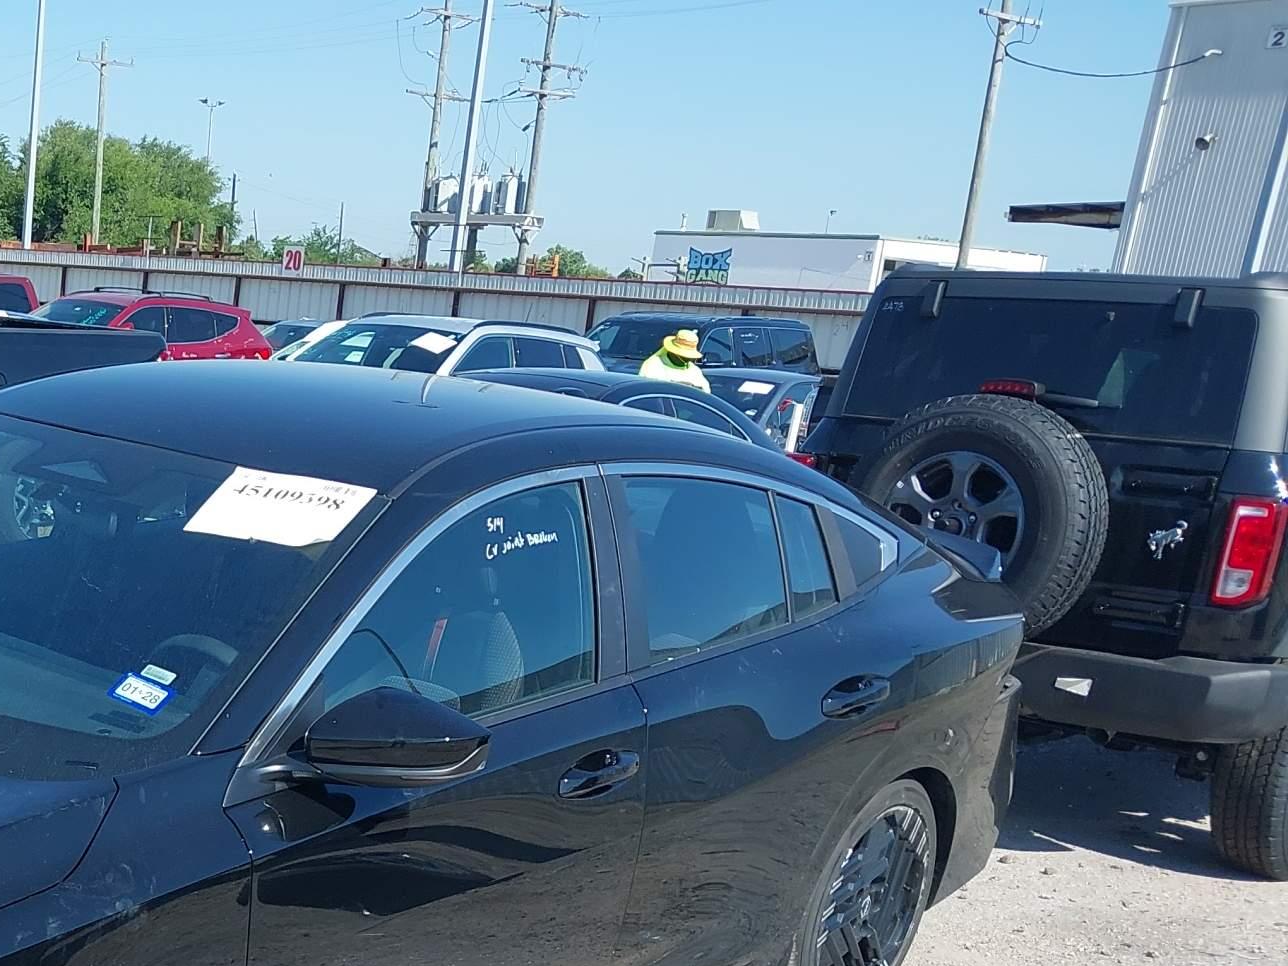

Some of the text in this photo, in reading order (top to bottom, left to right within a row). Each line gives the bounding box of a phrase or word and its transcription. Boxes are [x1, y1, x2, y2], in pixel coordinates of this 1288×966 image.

[1272, 31, 1286, 47] 2
[284, 249, 302, 271] 20
[688, 246, 733, 270] BOX
[686, 269, 729, 286] GANG
[233, 483, 345, 510] 45109398
